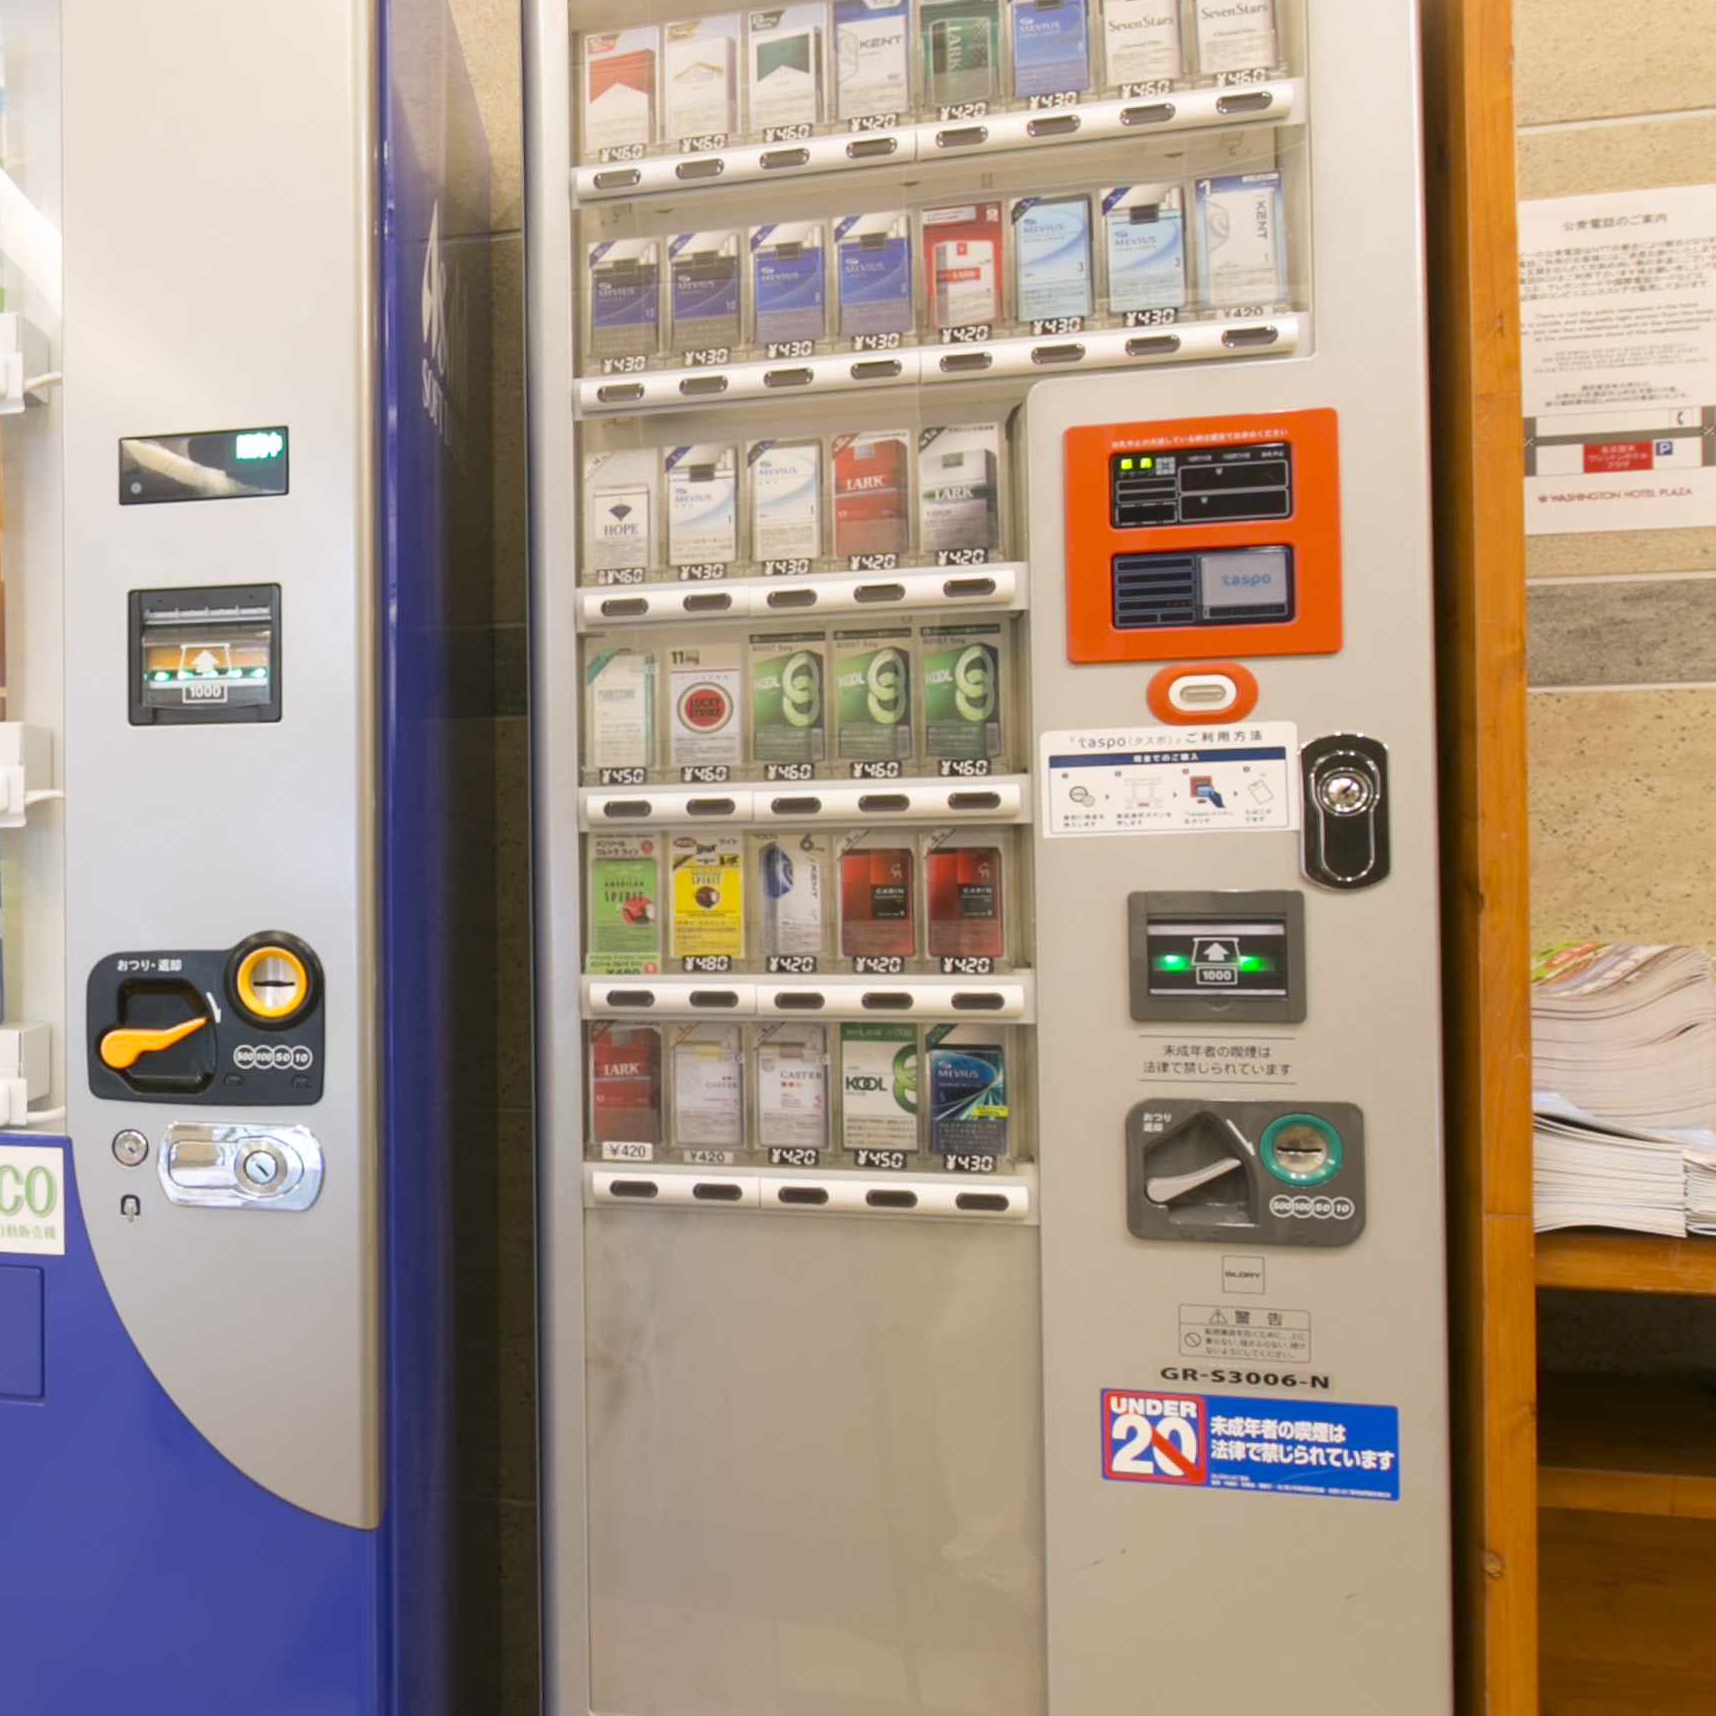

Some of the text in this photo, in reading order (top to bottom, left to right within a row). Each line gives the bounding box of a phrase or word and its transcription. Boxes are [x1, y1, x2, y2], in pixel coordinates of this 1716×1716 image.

[859, 36, 903, 50] KENT
[947, 26, 962, 70] LARK
[941, 103, 986, 120] ¥420
[1255, 200, 1268, 240] KENT
[1023, 223, 1065, 234] MEVIUS
[1115, 236, 1156, 247] MEVIUS
[1127, 309, 1176, 326] ¥430
[942, 326, 989, 343] ¥420
[768, 341, 813, 358] ¥430
[604, 357, 646, 373] ¥430
[759, 465, 798, 476] MEVIUS
[846, 475, 885, 491] LARK
[935, 485, 973, 500] LARK
[1551, 487, 1692, 503] WASHINGTON HOTEL PLAZA
[603, 524, 639, 537] HOPE
[939, 549, 984, 565] ¥420
[766, 559, 809, 574] ¥430
[607, 569, 643, 584] ¥460
[1221, 572, 1272, 587] taspo
[189, 686, 221, 697] 1000
[689, 697, 721, 708] LUCKY
[687, 707, 723, 719] STRIKE
[685, 766, 726, 782] ¥460
[854, 762, 899, 778] ¥460
[604, 890, 644, 904] SPIRIT
[118, 959, 181, 972] おつり・返却
[685, 956, 729, 971] ¥480
[856, 957, 902, 973] ¥420
[1203, 970, 1232, 981] 1000
[237, 1052, 308, 1062] 500 100 50 10
[1163, 1044, 1271, 1059] 未成年者の喫煙は
[604, 1062, 640, 1076] LARK
[780, 1070, 823, 1080] CASTER
[938, 1067, 979, 1080] MEVIUS
[1143, 1061, 1292, 1076] 法律で禁じられています
[846, 1076, 888, 1092] KOOL
[1144, 1112, 1172, 1122] おつり
[1144, 1122, 1163, 1132] 返却
[609, 1144, 646, 1158] ¥420
[772, 1149, 816, 1165] ¥420
[946, 1155, 993, 1172] ¥430
[1274, 1201, 1349, 1212] 500 100 50 10
[1161, 1367, 1330, 1389] GR-S3006-N
[1110, 1396, 1197, 1418] UNDER
[1210, 1416, 1346, 1443] 未成年者の喫煙は
[1111, 1413, 1197, 1476] 20
[1210, 1439, 1394, 1470] 法律で禁じられています
